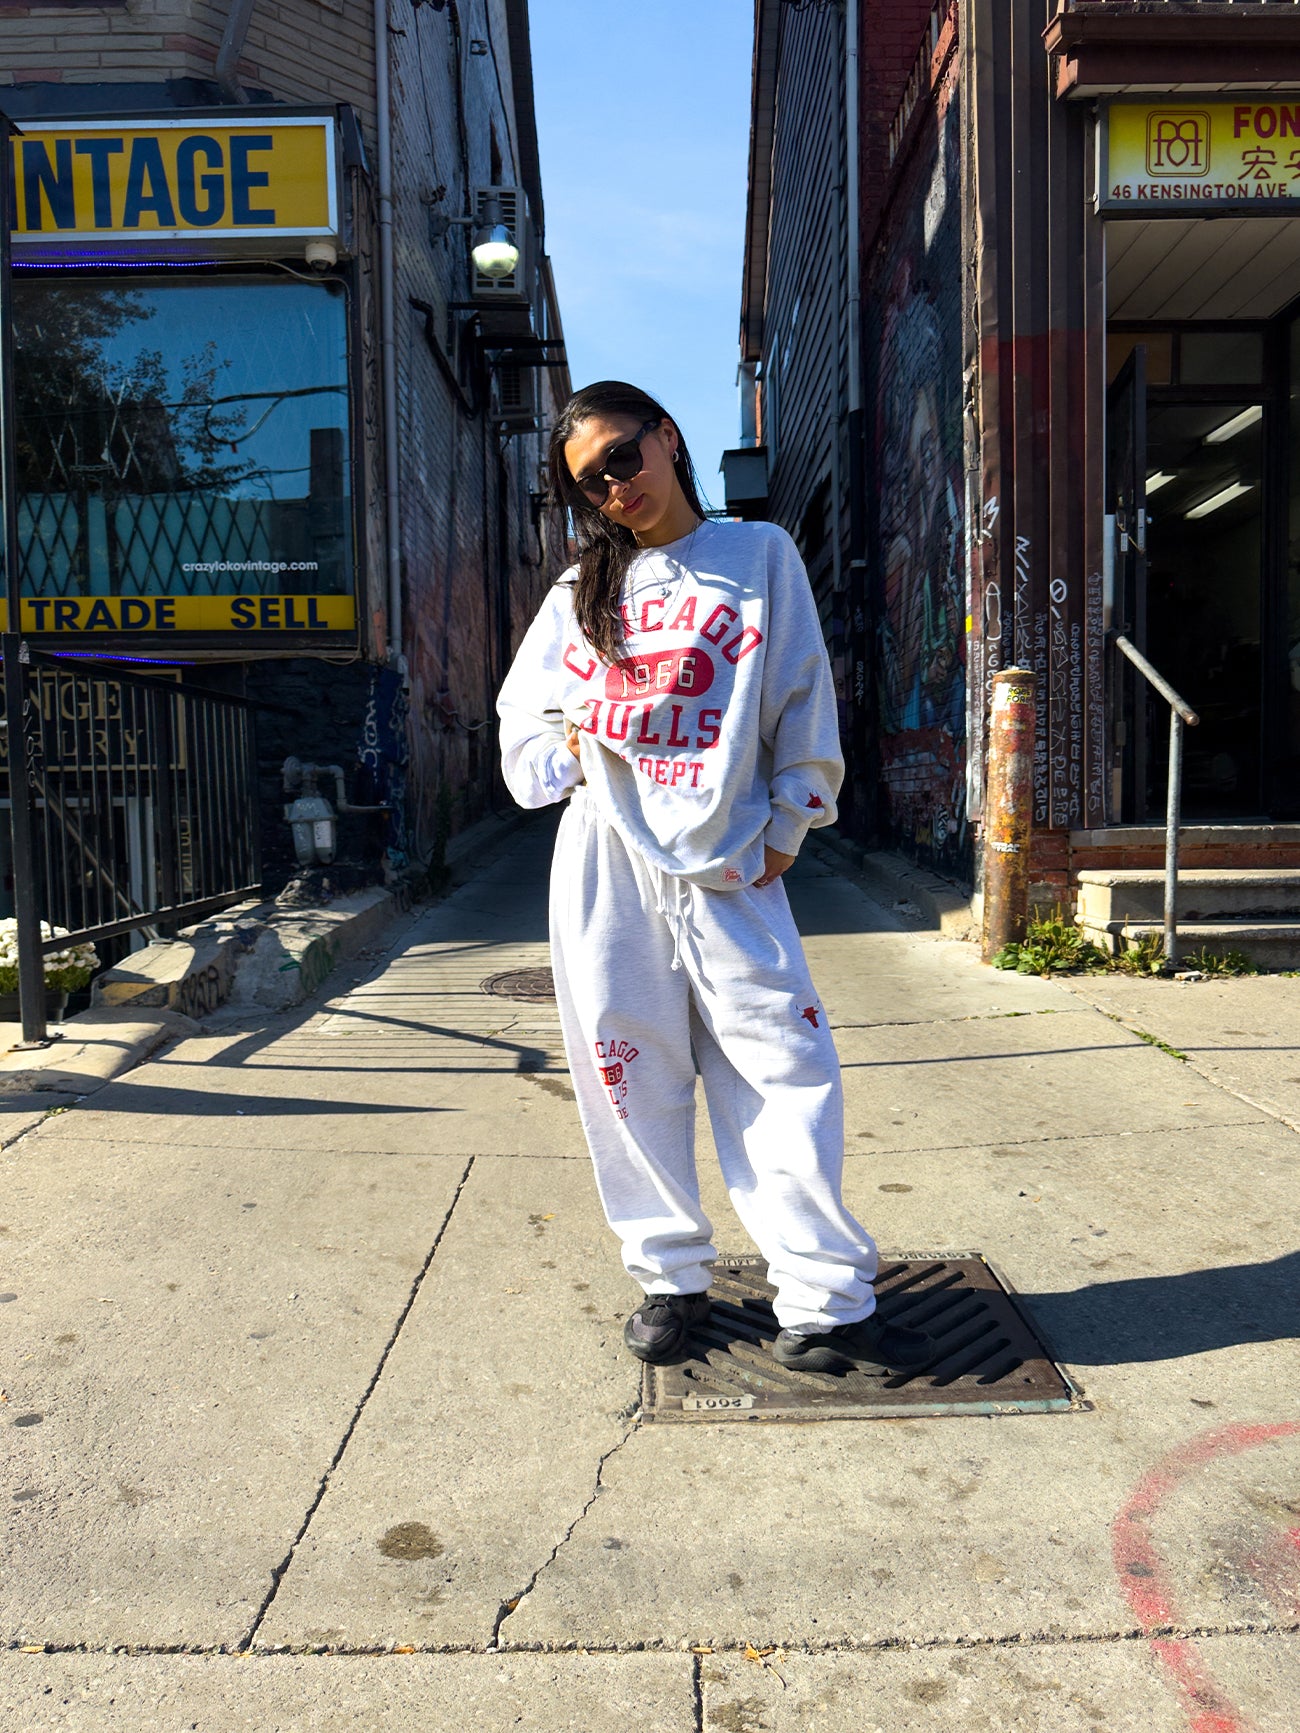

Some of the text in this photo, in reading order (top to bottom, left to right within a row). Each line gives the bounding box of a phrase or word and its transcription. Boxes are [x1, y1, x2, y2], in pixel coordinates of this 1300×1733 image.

[1112, 183, 1293, 199] 46 KENSINGTON AVE.
[182, 560, 319, 574] crazylokovintage.com
[28, 597, 328, 630] TRADE SELL
[620, 656, 697, 699] 1966
